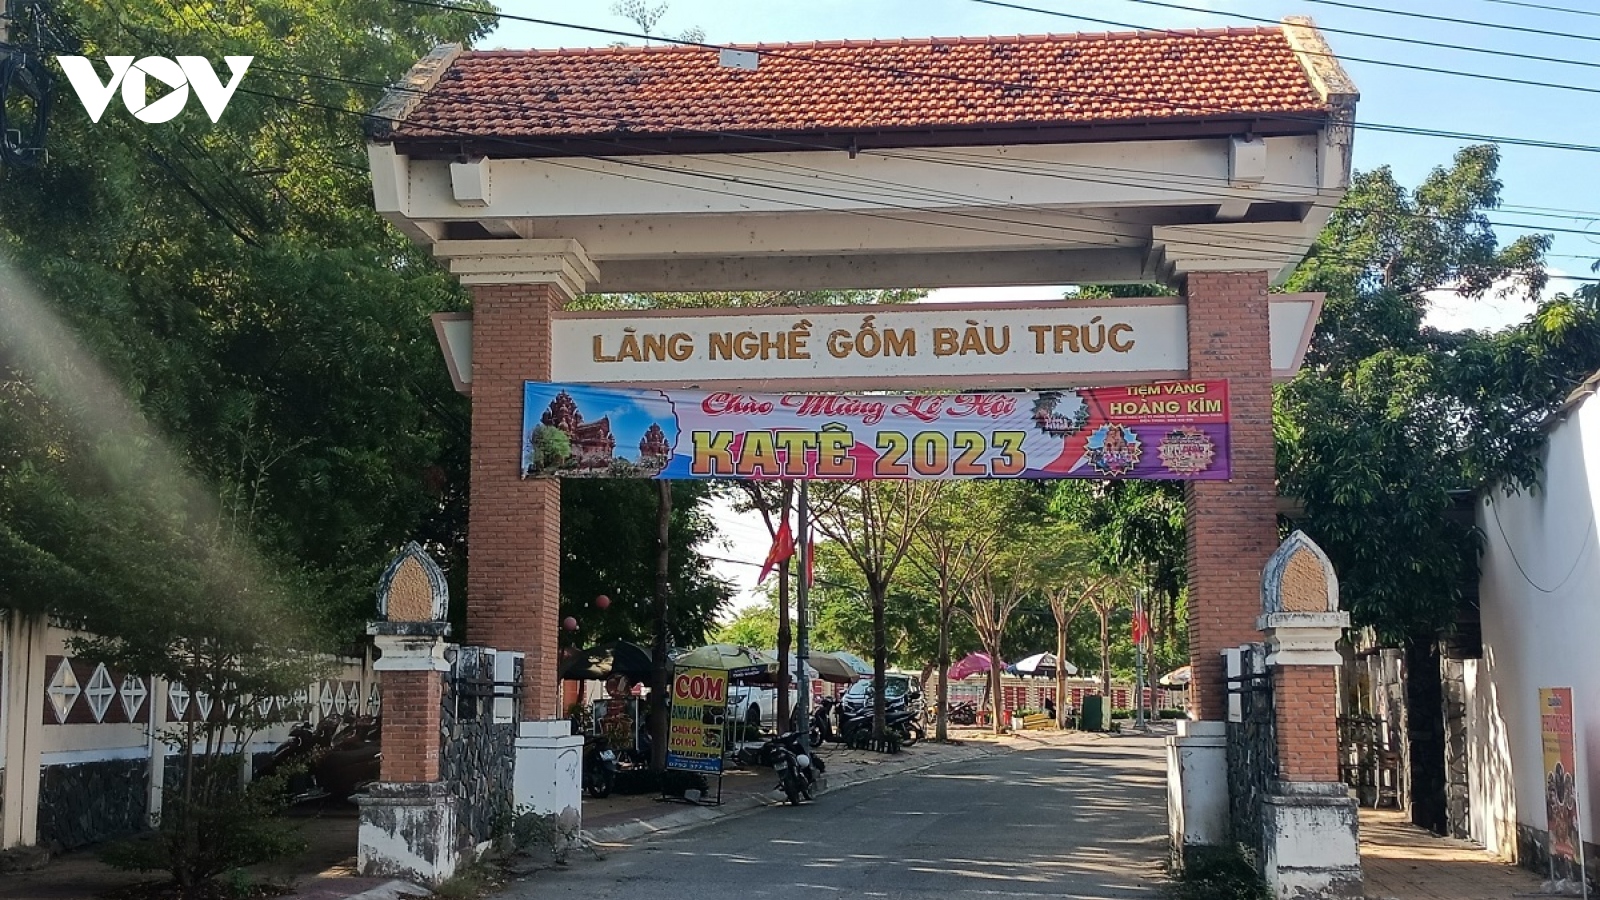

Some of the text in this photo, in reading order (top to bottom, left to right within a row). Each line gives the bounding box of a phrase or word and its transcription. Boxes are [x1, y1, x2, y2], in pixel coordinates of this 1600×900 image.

[592, 314, 1136, 363] LÀNG NGHỀ GỐM BÀU TRÚC
[1163, 382, 1207, 395] VÀNG
[701, 391, 775, 417] Chào
[779, 394, 889, 426] Mừng
[946, 394, 1018, 419] Hội
[1110, 398, 1181, 416] HOÀNG
[691, 421, 1027, 477] KATÊ 2023
[675, 671, 724, 702] CƠM
